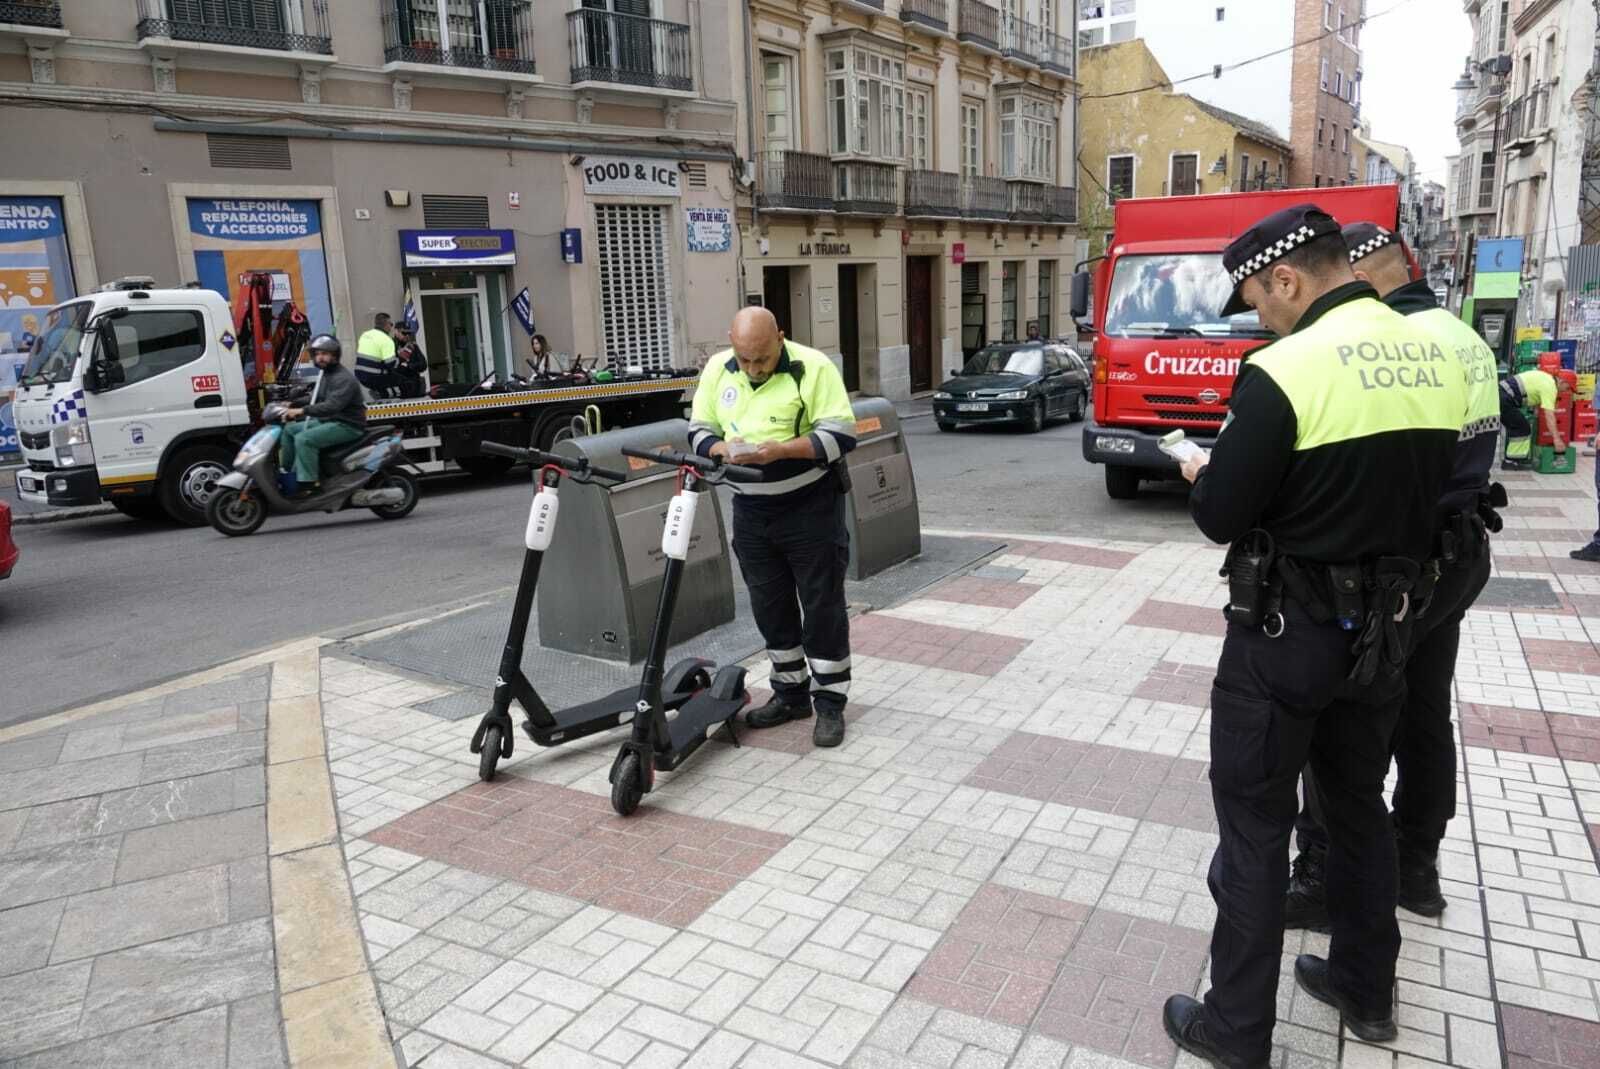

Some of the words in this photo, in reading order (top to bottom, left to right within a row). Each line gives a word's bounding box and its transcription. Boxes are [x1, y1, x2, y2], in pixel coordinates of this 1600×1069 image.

[584, 162, 630, 185] FOOD
[634, 164, 647, 180] &
[652, 166, 677, 188] ICE
[201, 212, 308, 223] REPARACIONES
[205, 224, 216, 234] Y
[220, 224, 307, 234] ACCESORIOS
[800, 242, 812, 256] LA
[815, 242, 852, 255] TRANCA
[1336, 341, 1447, 366] POLICIA
[1358, 366, 1444, 390] LOCAL
[536, 503, 549, 533] BIRD
[670, 505, 683, 536] BIRD
